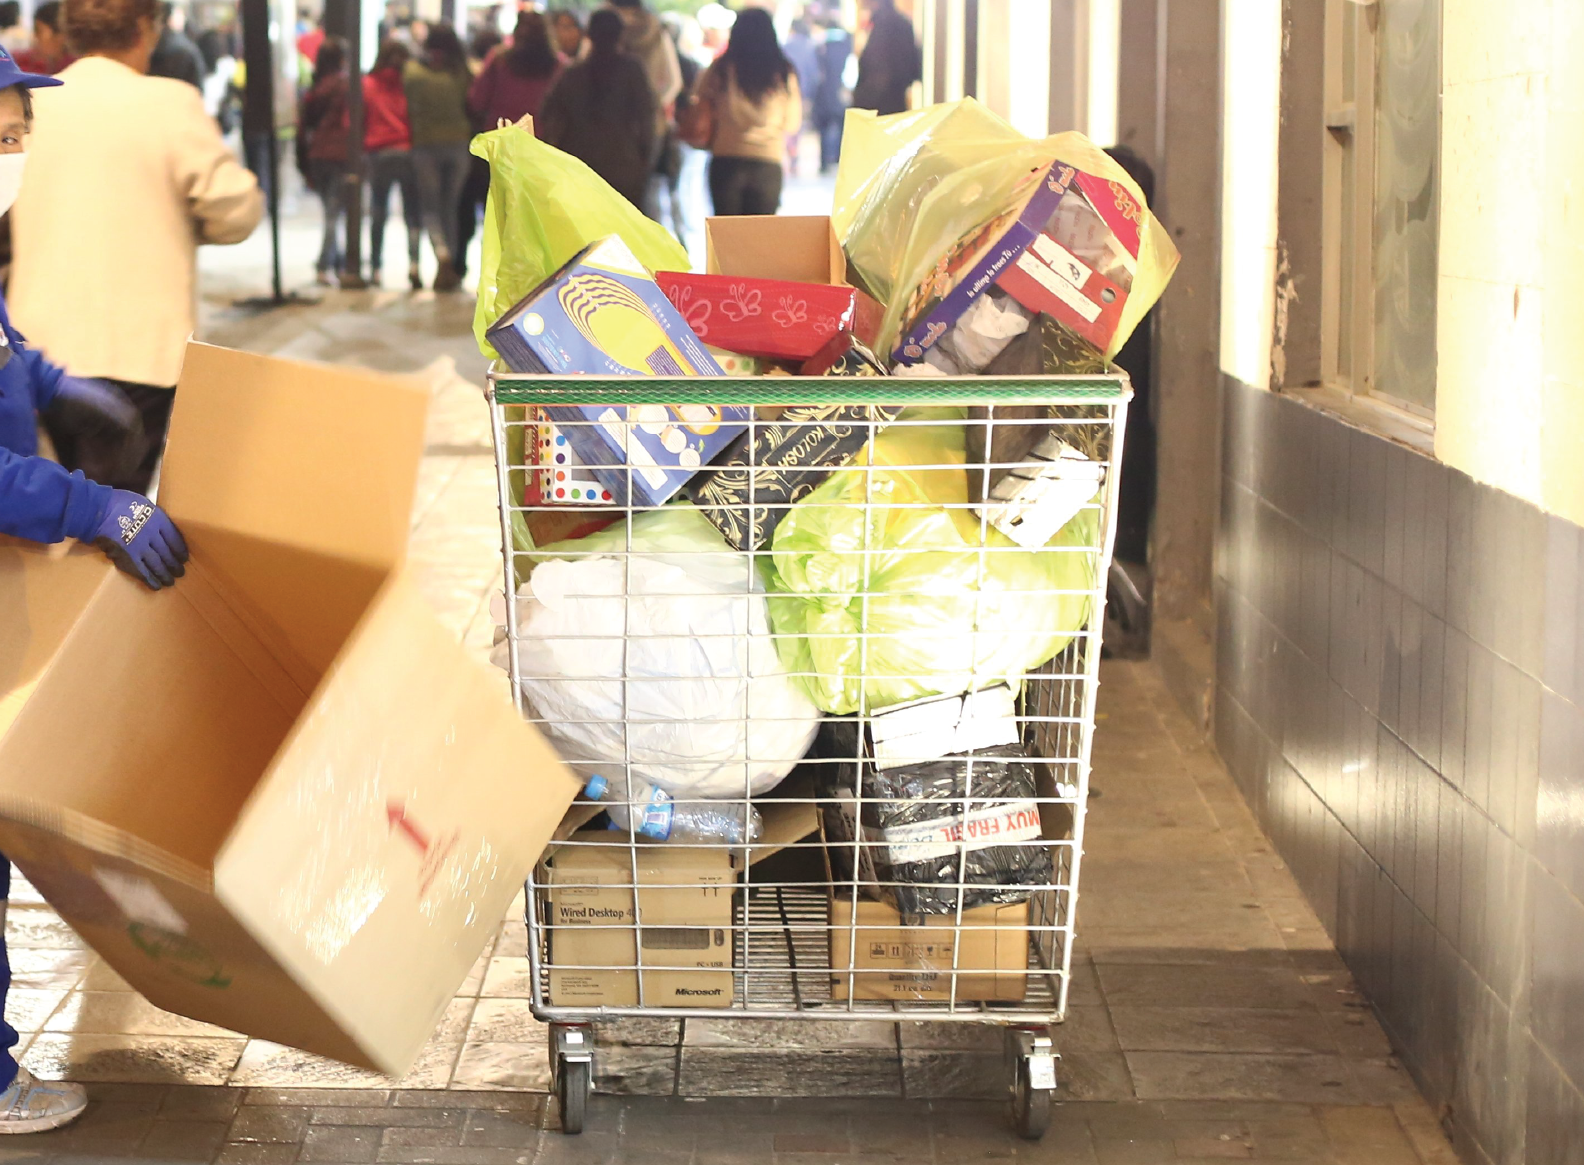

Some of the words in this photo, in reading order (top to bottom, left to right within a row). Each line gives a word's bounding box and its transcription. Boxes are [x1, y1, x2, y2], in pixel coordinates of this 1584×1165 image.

[777, 425, 825, 475] KOLOSH
[1004, 810, 1040, 832] MUY
[560, 907, 586, 918] Wired
[588, 907, 624, 921] Desktop
[675, 988, 722, 996] Microsoft
